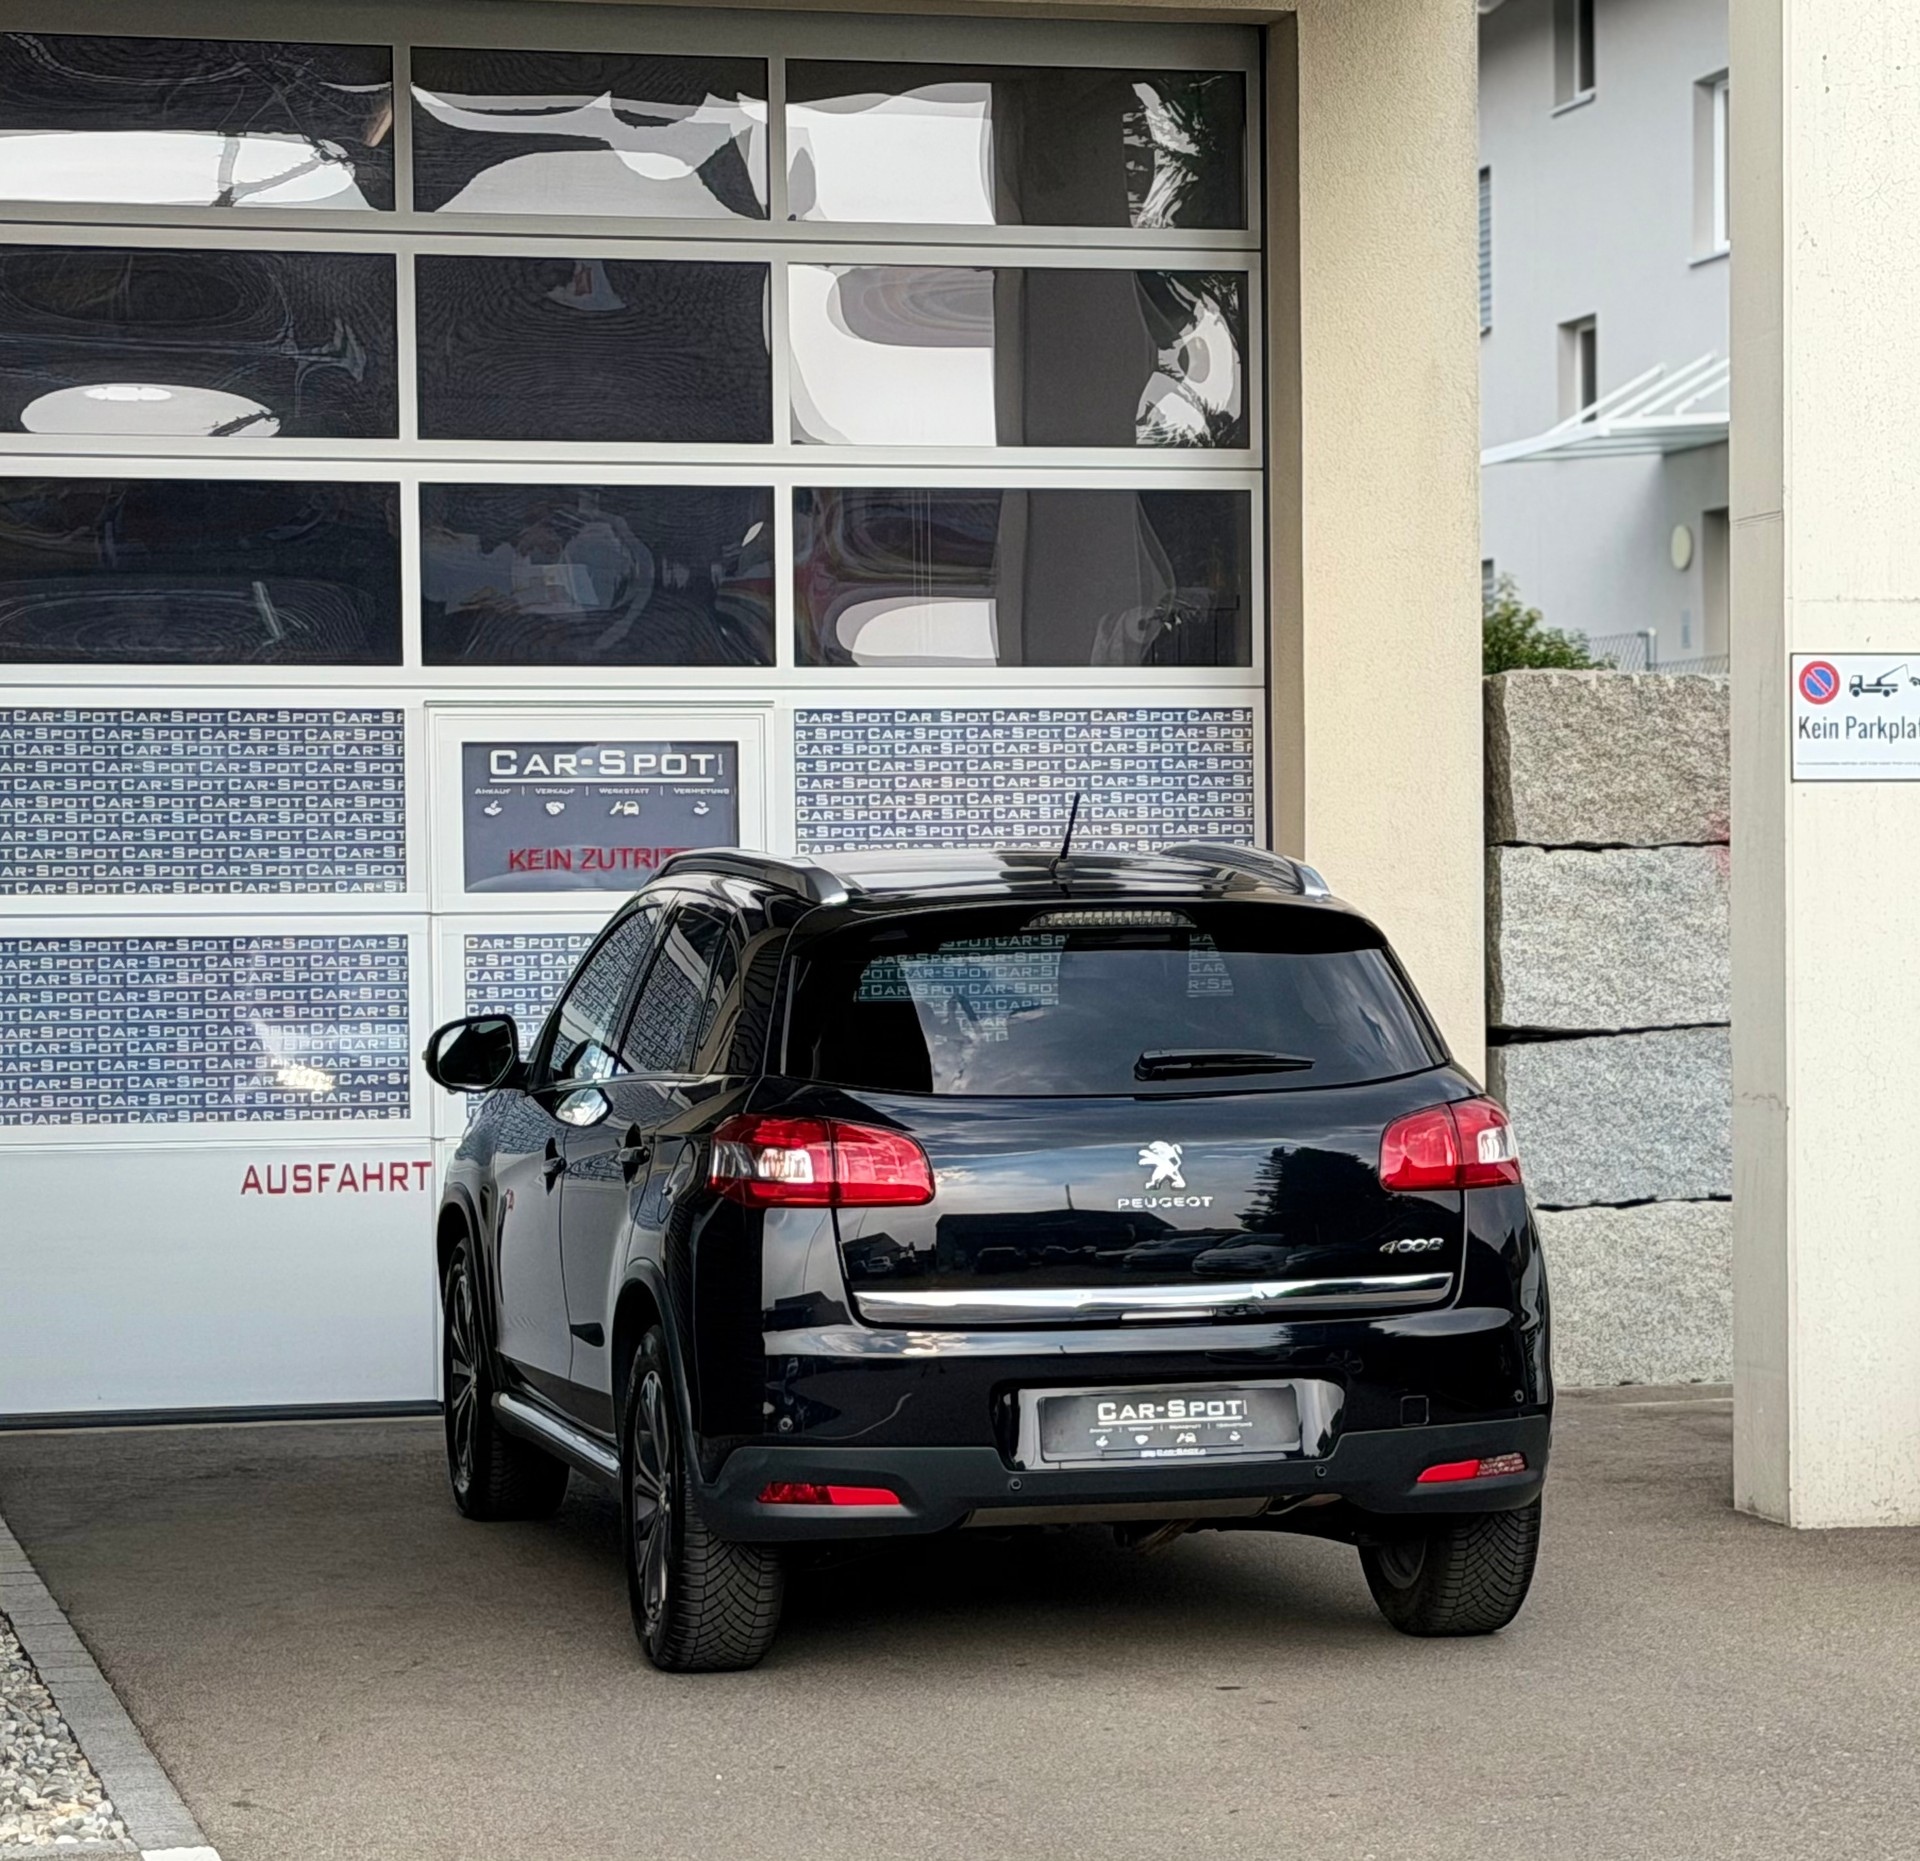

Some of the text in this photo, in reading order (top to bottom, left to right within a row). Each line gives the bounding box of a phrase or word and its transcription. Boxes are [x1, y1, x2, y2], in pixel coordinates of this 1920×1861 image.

[14, 710, 118, 722] CAR-SPOT
[121, 711, 224, 722] CAR-SPOT
[227, 711, 331, 723] CAR-SPOT
[796, 712, 892, 722] CAR-SPOT
[993, 711, 1088, 722] CAR-SPOT
[1091, 710, 1185, 721] CAR-SPOT
[92, 728, 196, 740] CAR-SPOT
[200, 729, 303, 740] CAR-SPOT
[868, 728, 964, 739] CAR-SPOT
[966, 728, 1061, 739] CAR-SPOT
[1065, 727, 1159, 738] CAR-SPOT
[1798, 716, 1838, 740] Kein
[14, 744, 118, 755] CAR-SPOT
[121, 744, 225, 755] CAR-SPOT
[228, 744, 331, 755] CAR-SPOT
[796, 744, 892, 755] CAR-SPOT
[895, 743, 990, 754] CAR-SPOT
[993, 742, 1088, 753] CAR-SPOT
[1091, 742, 1185, 753] CAR-SPOT
[93, 762, 196, 773] CAR-SPOT
[200, 762, 303, 773] CAR-SPOT
[490, 750, 715, 775] CAR-SPOT
[869, 760, 964, 771] CAR-SPOT
[967, 759, 1062, 770] CAR-SPOT
[15, 779, 118, 790] CAR-SPOT
[122, 779, 225, 790] CAR-SPOT
[228, 779, 331, 790] CAR-SPOT
[797, 777, 892, 788] CAR-SPOT
[896, 777, 990, 788] CAR-SPOT
[993, 776, 1088, 787] CAR-SPOT
[1091, 775, 1185, 786] CAR-SPOT
[93, 796, 197, 808] CAR-SPOT
[200, 796, 303, 807] CAR-SPOT
[869, 794, 965, 805] CAR-SPOT
[967, 793, 1062, 804] CAR-SPOT
[15, 812, 119, 823] CAR-SPOT
[122, 812, 226, 823] CAR-SPOT
[229, 812, 332, 823] CAR-SPOT
[797, 809, 893, 820] CAR-SPOT
[896, 808, 990, 820] CAR-SPOT
[1091, 806, 1186, 818] CAR-SPOT
[93, 829, 197, 840] CAR-SPOT
[201, 829, 303, 840] CAR-SPOT
[869, 825, 965, 836] CAR-SPOT
[967, 824, 1062, 836] CAR-SPOT
[16, 847, 120, 859] CAR-SPOT
[123, 847, 226, 858] CAR-SPOT
[229, 847, 332, 858] CAR-SPOT
[510, 848, 695, 870] KEIN ZUTRI
[94, 865, 197, 876] CAR-SPOT
[201, 864, 303, 876] CAR-SPOT
[16, 883, 120, 894] CAR-SPOT
[123, 882, 226, 894] CAR-SPOT
[230, 881, 332, 893] CAR-SPOT
[19, 940, 123, 952] CAR-SPOT
[126, 939, 230, 951] CAR-SPOT
[338, 937, 406, 949] CAR-S
[466, 937, 566, 948] CAR-SPOT
[0, 957, 95, 969] AR-SPOT
[98, 957, 201, 968] CAR-SPOT
[19, 973, 123, 985] CAR-SPOT
[127, 972, 230, 984] CAR-SPOT
[339, 970, 406, 982] CAR-S
[0, 991, 95, 1002] AR-SPOT
[98, 990, 201, 1002] CAR-SPOT
[19, 1008, 123, 1020] CAR-SPOT
[127, 1007, 230, 1019] CAR-SPOT
[339, 1005, 407, 1017] CAR-S
[0, 1026, 95, 1038] AR-SPOT
[98, 1025, 201, 1037] CAR-SPOT
[20, 1041, 124, 1054] CAR-SPOT
[127, 1040, 230, 1052] CAR-SPOT
[339, 1038, 407, 1050] CAR-S
[0, 1059, 95, 1072] AR-SPOT
[98, 1058, 201, 1070] CAR-SPOT
[20, 1077, 124, 1089] CAR-SPOT
[128, 1076, 230, 1088] CAR-SPOT
[340, 1074, 407, 1086] CAR-S
[0, 1095, 95, 1107] AR-SPOT
[98, 1093, 201, 1106] CAR-SPOT
[20, 1112, 124, 1125] CAR-SPOT
[128, 1110, 231, 1123] CAR-SPOT
[340, 1107, 408, 1119] CAR-S
[240, 1161, 432, 1194] AUSFAHRT
[1118, 1196, 1214, 1208] PEUGEOT
[1098, 1400, 1242, 1420] CAR-SPOT
